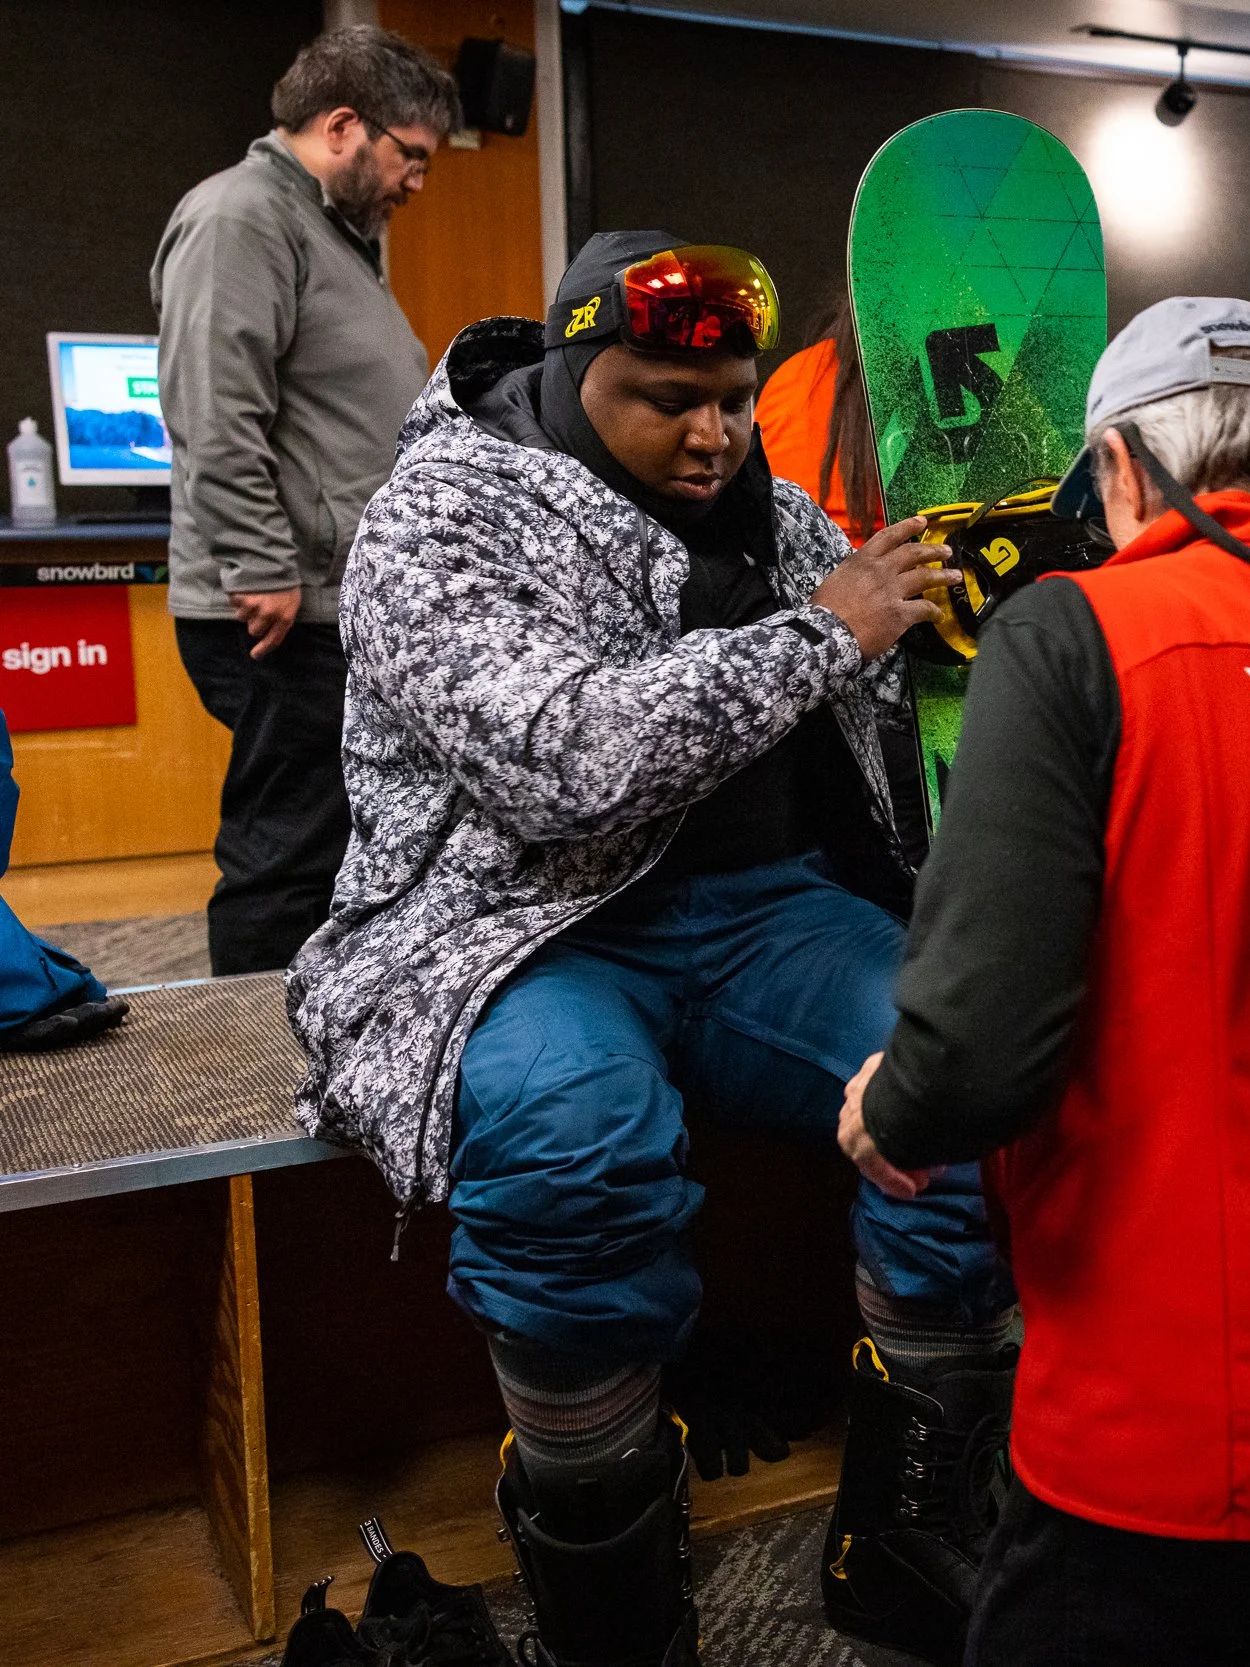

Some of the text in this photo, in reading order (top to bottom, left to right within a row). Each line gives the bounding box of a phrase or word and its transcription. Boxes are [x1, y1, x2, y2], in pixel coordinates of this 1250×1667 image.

[37, 562, 135, 581] snowbird
[2, 638, 108, 675] sign in
[366, 1525, 384, 1554] BANDES
